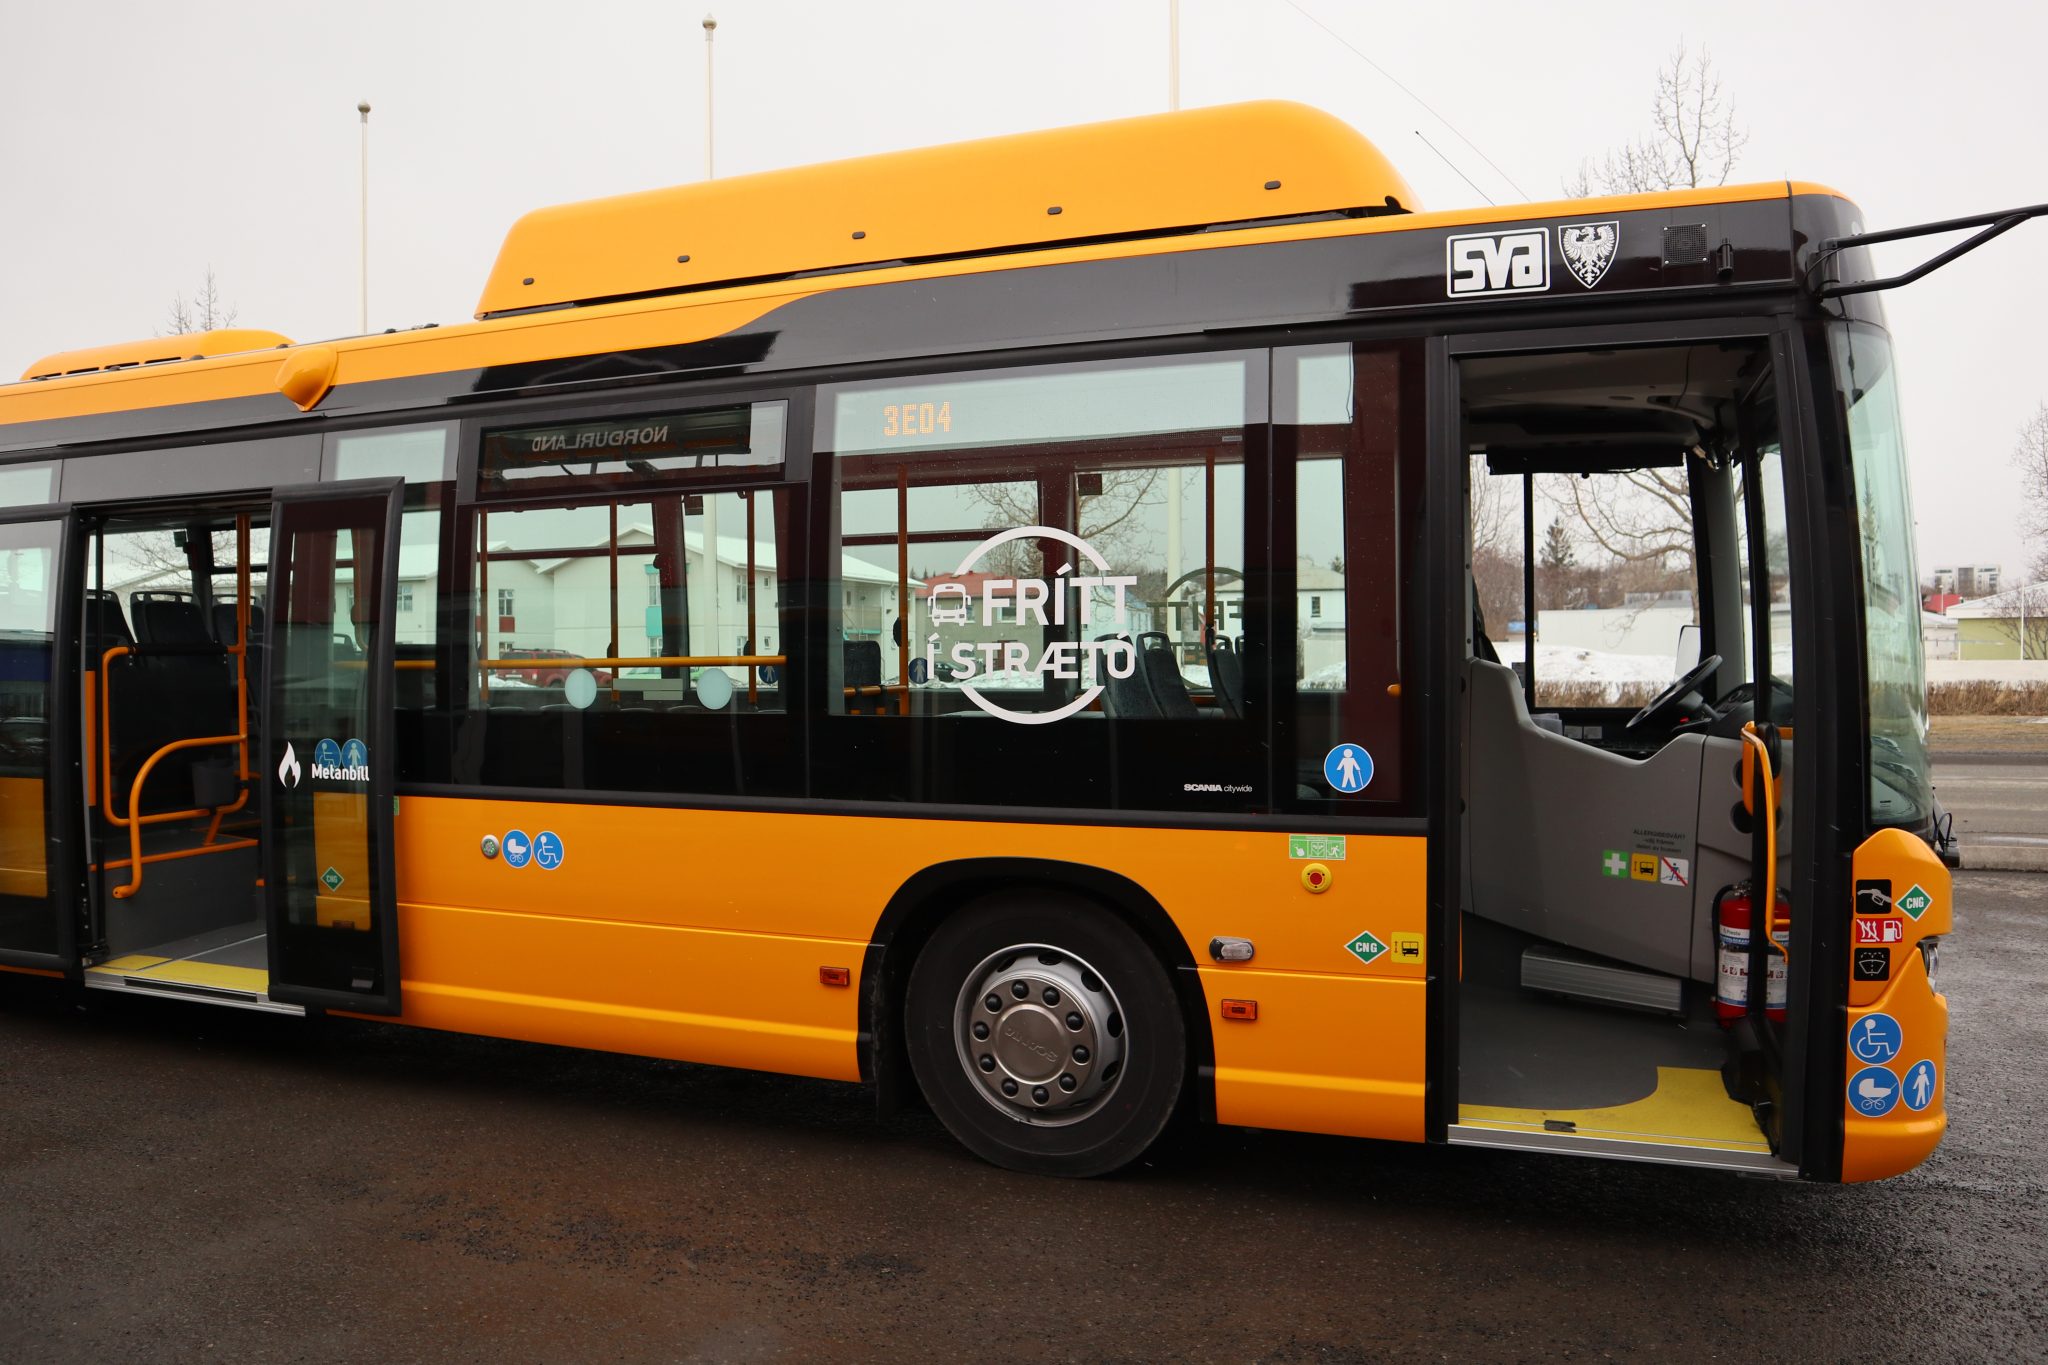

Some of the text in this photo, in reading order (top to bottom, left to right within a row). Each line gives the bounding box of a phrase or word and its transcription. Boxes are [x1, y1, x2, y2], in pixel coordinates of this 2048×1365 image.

[883, 401, 952, 436] 3E04
[982, 562, 1138, 627] FRÍTT
[926, 632, 940, 680] Í
[950, 630, 1136, 680] STRÆTÓ
[1183, 783, 1253, 794] SCANIA citywide
[1906, 896, 1924, 909] CNG
[1355, 942, 1378, 953] CNG
